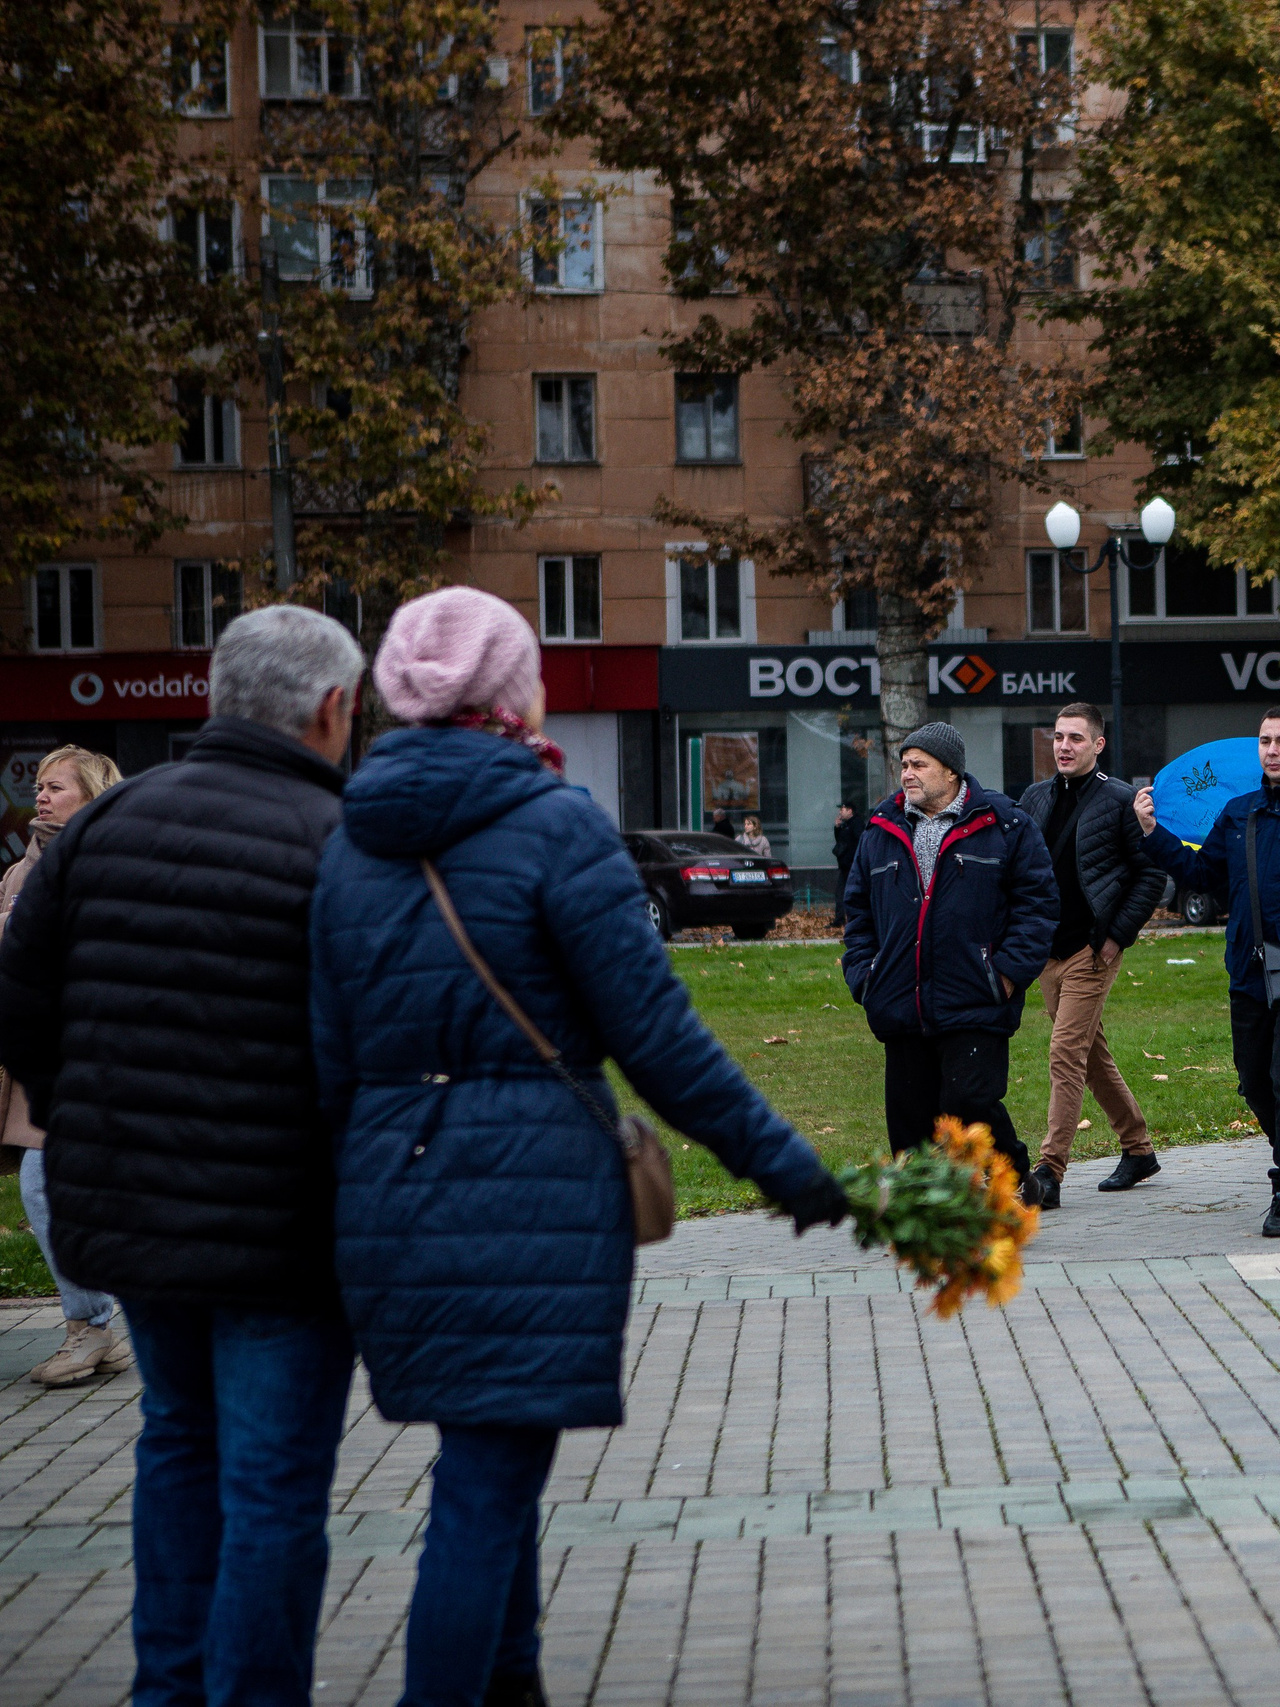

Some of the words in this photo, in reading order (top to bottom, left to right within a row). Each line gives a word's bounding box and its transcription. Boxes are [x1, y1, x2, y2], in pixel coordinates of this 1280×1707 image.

[113, 673, 209, 697] vodafo
[750, 655, 967, 697] ВОСТК
[1002, 672, 1076, 695] БАНК
